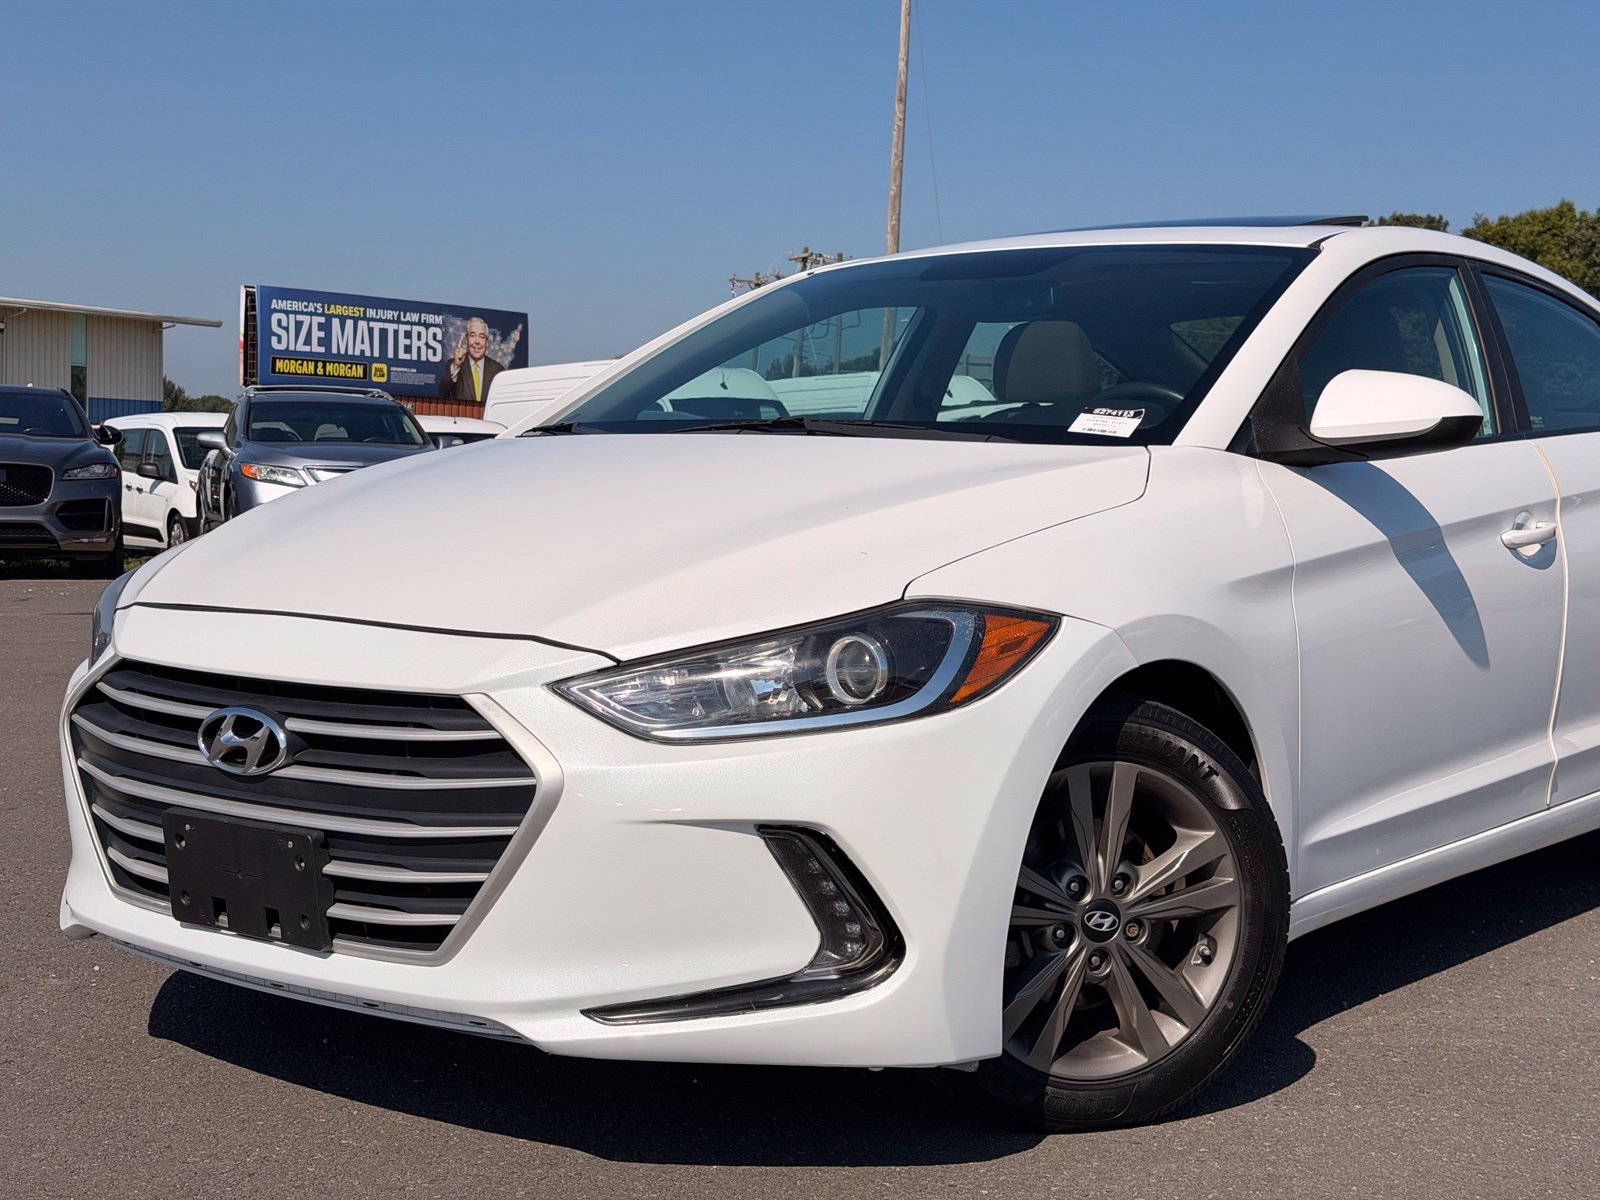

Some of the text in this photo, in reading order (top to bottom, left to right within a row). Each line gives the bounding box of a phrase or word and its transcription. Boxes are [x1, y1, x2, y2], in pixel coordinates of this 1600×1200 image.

[271, 299, 443, 325] AMERICA'S LARGEST INJURY LAW FIRM
[271, 312, 443, 363] SIZE MATTERS
[275, 359, 364, 378] MORGAN & MORGAN
